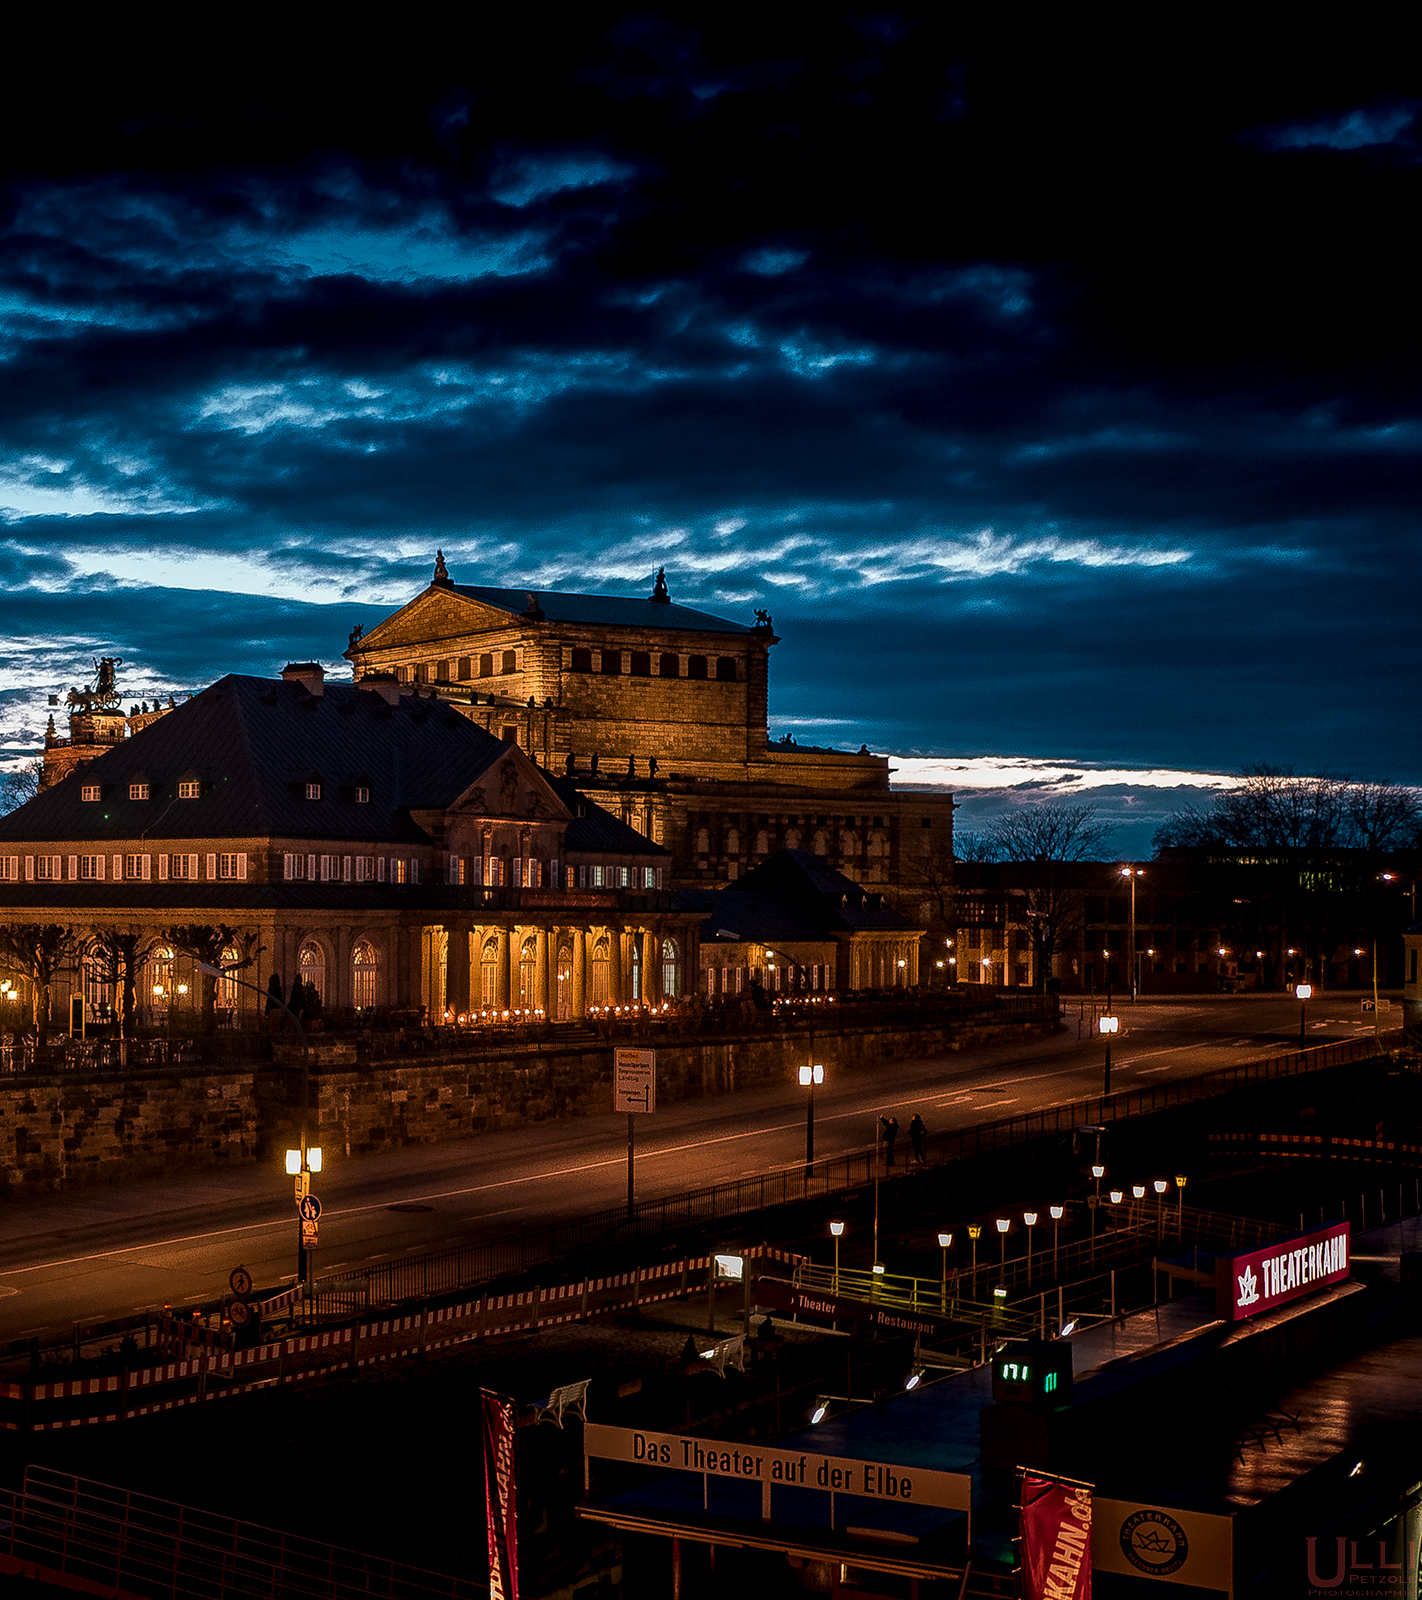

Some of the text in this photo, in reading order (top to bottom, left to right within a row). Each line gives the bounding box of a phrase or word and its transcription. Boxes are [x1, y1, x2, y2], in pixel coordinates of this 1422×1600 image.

[1262, 1233, 1347, 1298] THEATERKAHN
[798, 1294, 836, 1314] Theater
[877, 1310, 934, 1335] Restaurant
[633, 1433, 913, 1498] Das Theater auf der Elbe
[1122, 1512, 1185, 1547] THEATERKAHN
